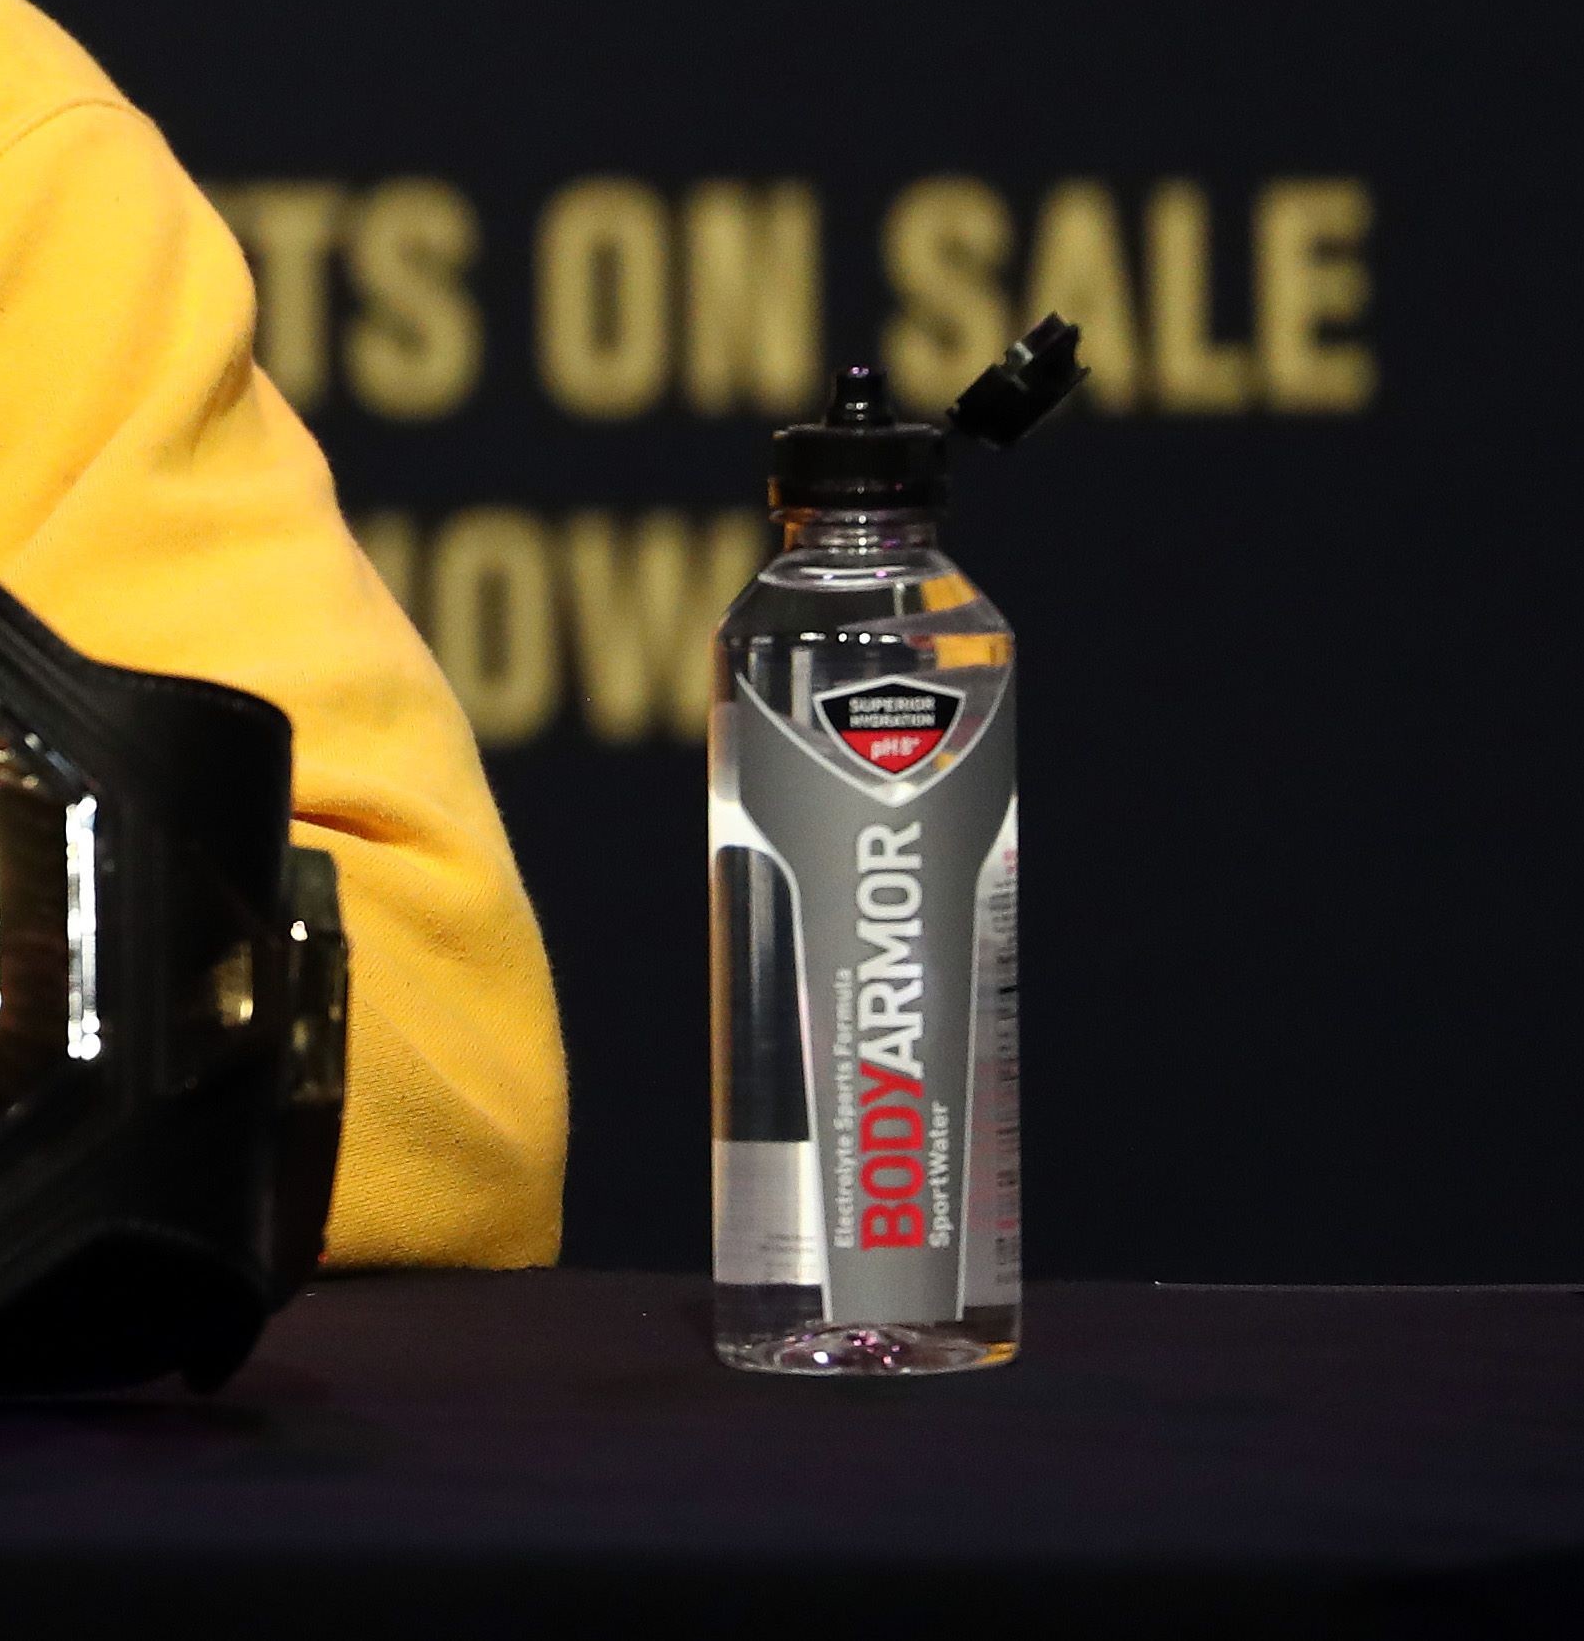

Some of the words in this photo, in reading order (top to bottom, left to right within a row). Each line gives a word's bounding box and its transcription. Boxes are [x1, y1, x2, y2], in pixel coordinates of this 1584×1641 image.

[536, 179, 821, 417] ON
[885, 178, 1373, 411] SALE
[855, 821, 926, 1251] BODYARMOR
